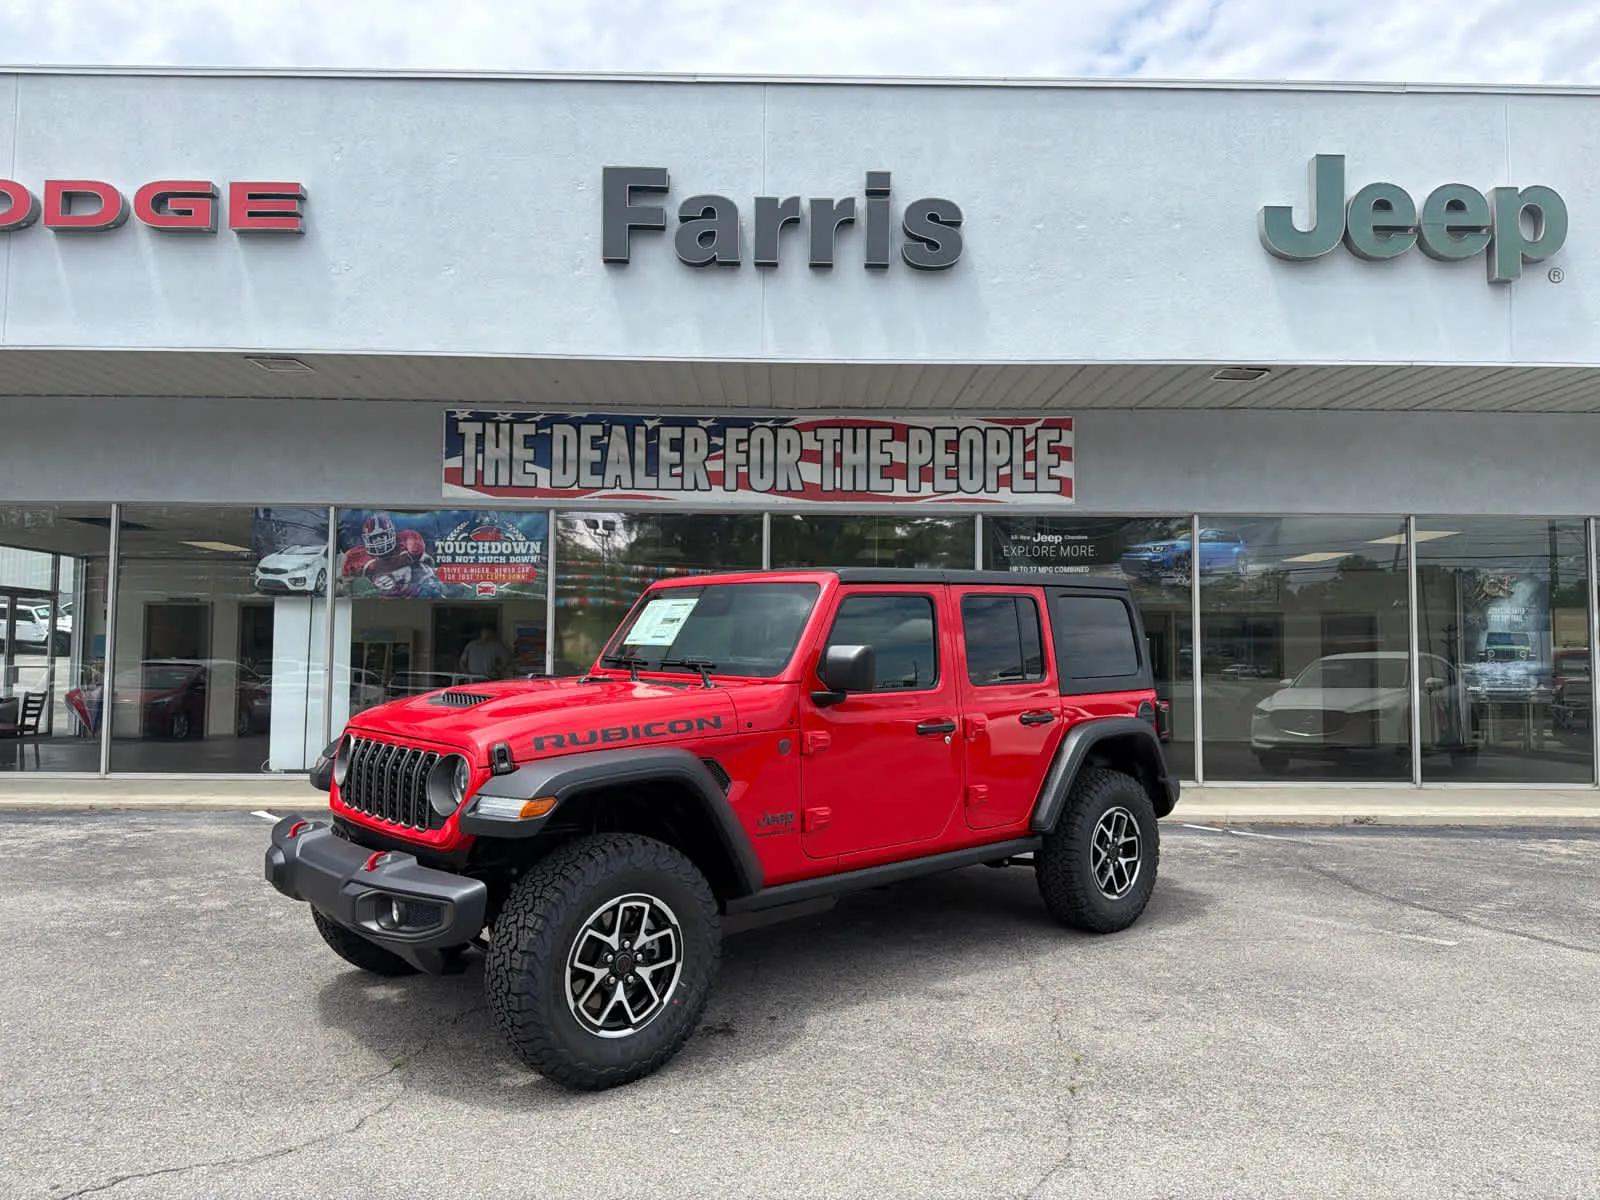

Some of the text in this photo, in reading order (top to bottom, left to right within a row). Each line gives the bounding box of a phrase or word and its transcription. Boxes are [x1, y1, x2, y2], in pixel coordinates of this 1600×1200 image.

[602, 166, 964, 271] Farris
[1257, 154, 1568, 284] Jeep
[458, 421, 1063, 494] THE DEALER FOR THE PEOPLE
[1032, 532, 1063, 544] Jeep
[435, 541, 542, 554] TOUCHDOWN
[1003, 545, 1057, 557] EXPLORE
[436, 554, 541, 564] FOR NOT MUCH DOWN!
[1020, 566, 1029, 574] TO
[1029, 566, 1037, 574] 37
[1038, 566, 1054, 574] MPG
[533, 715, 723, 752] RUBICON
[757, 810, 795, 828] Jeep
